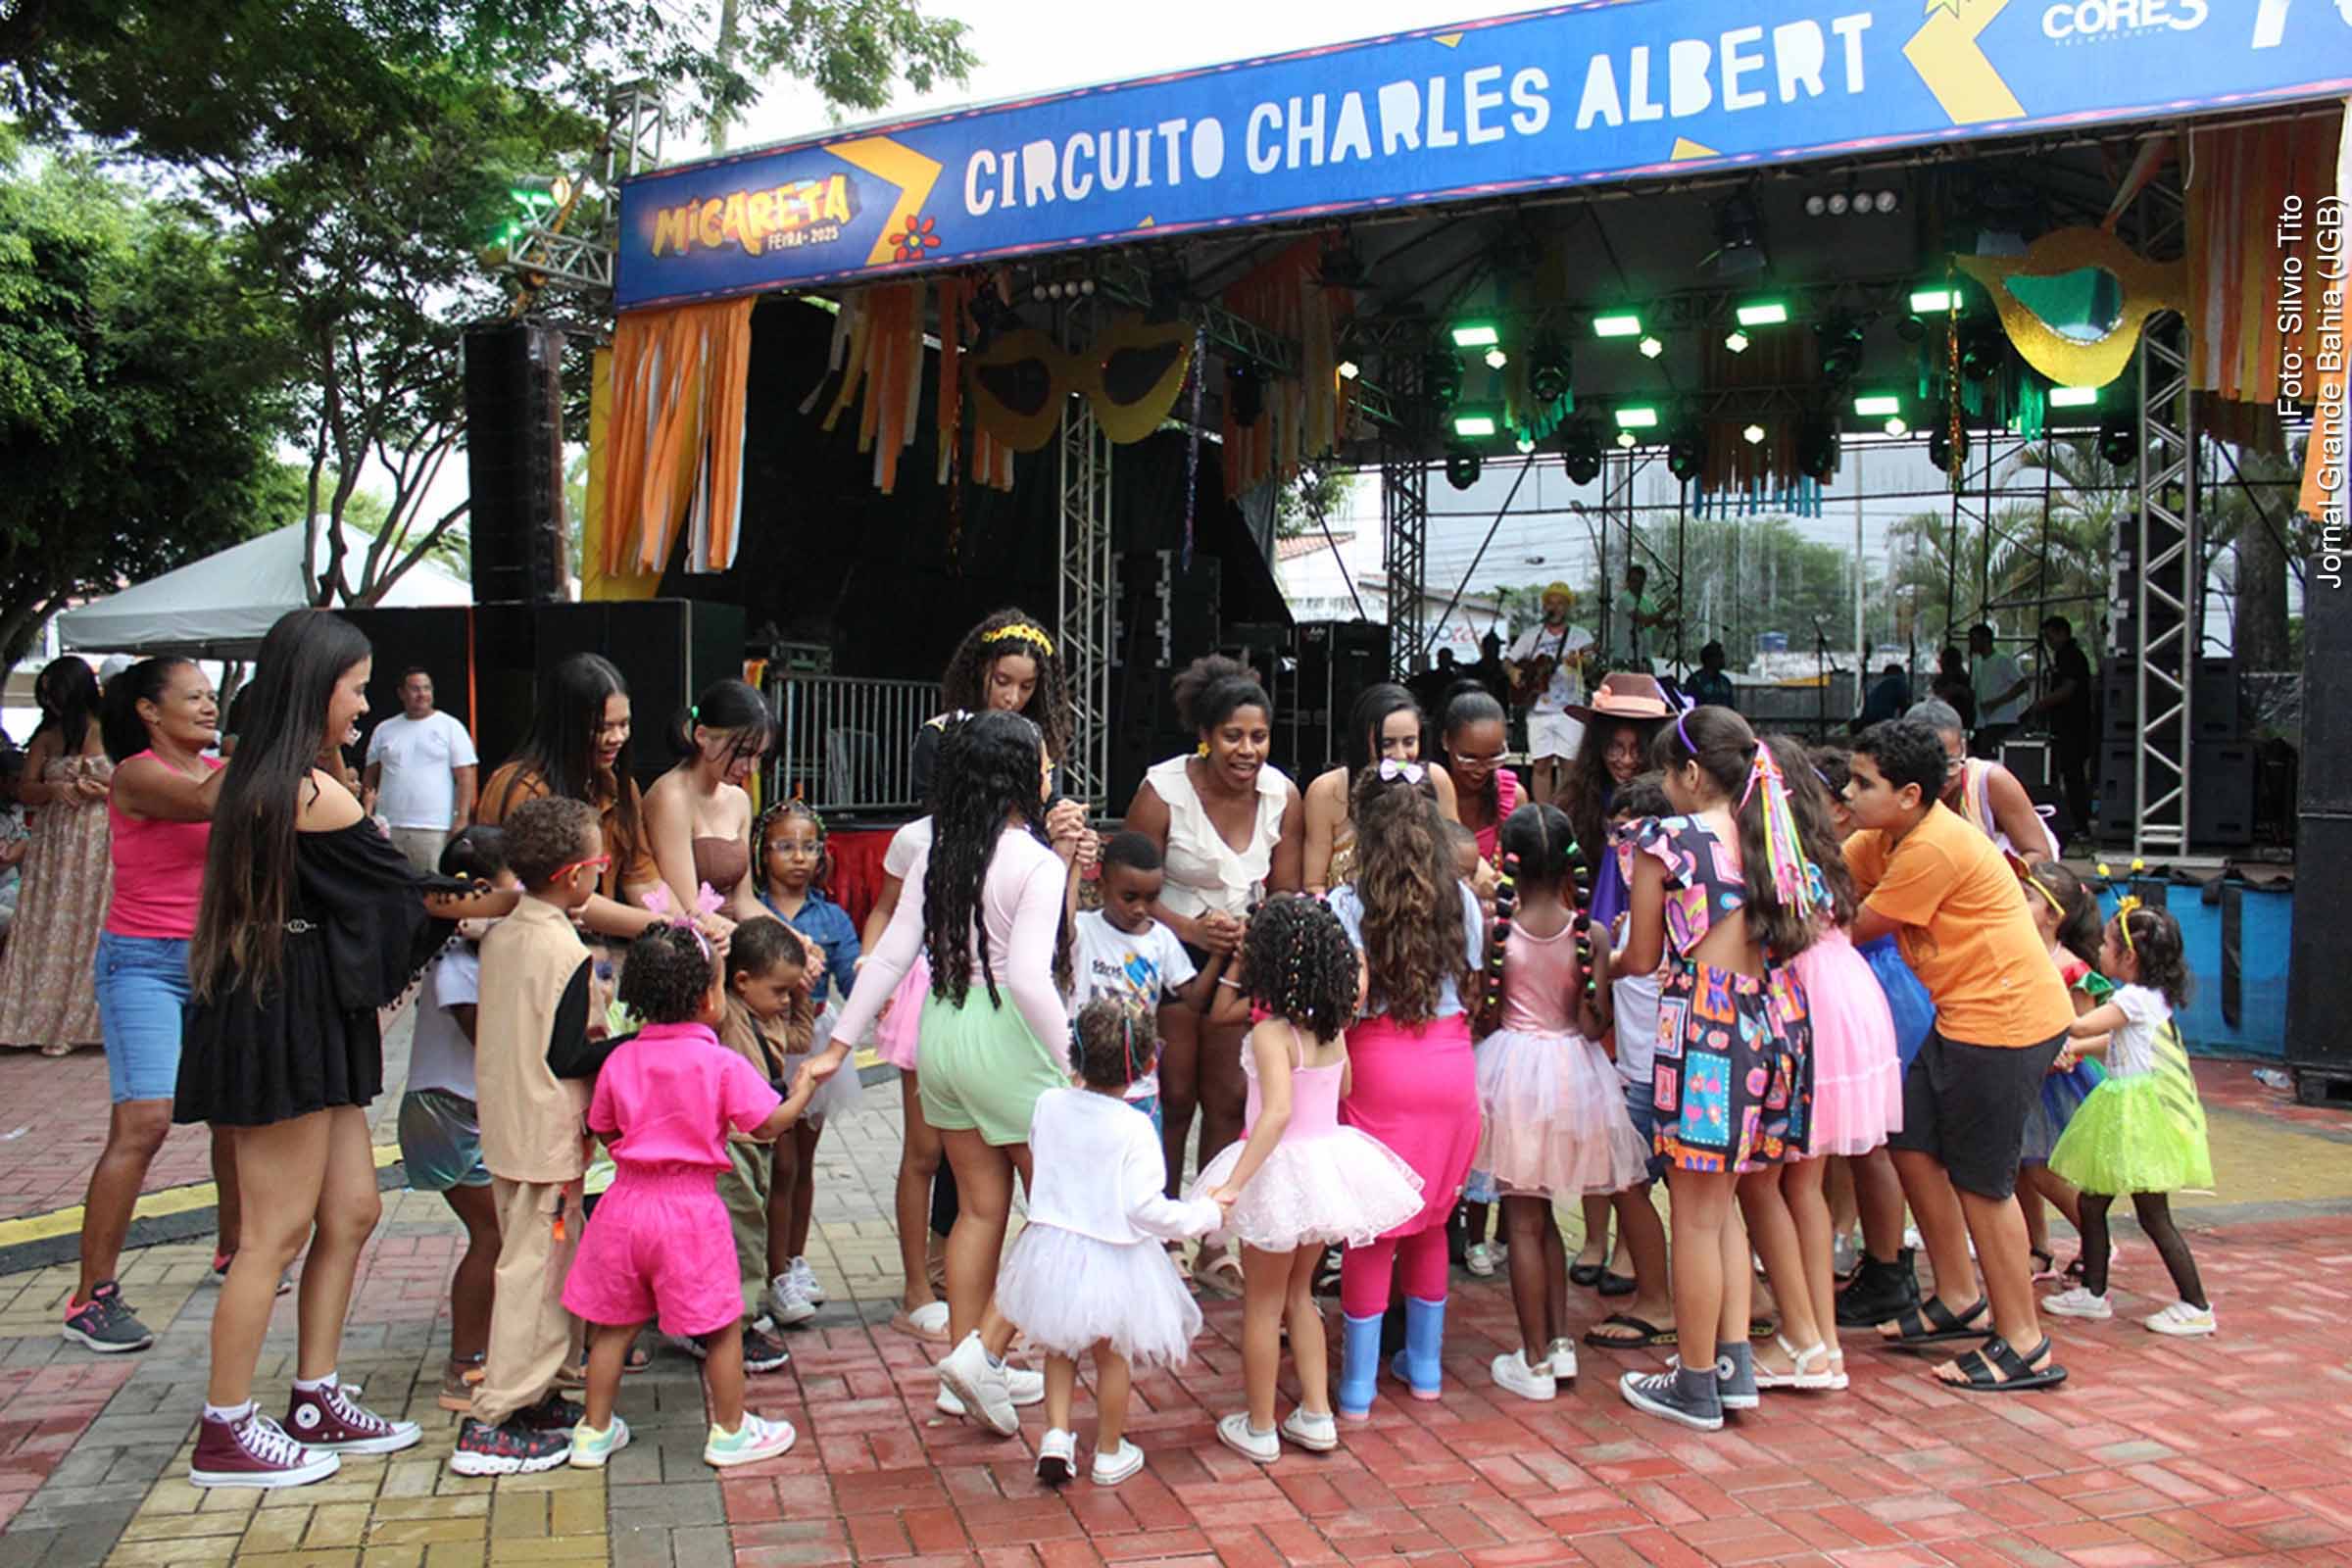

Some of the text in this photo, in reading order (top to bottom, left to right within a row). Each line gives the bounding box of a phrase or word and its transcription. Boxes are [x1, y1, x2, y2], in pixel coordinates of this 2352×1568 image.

[964, 14, 1873, 216] CIRCUITO CHARLES ALBERT
